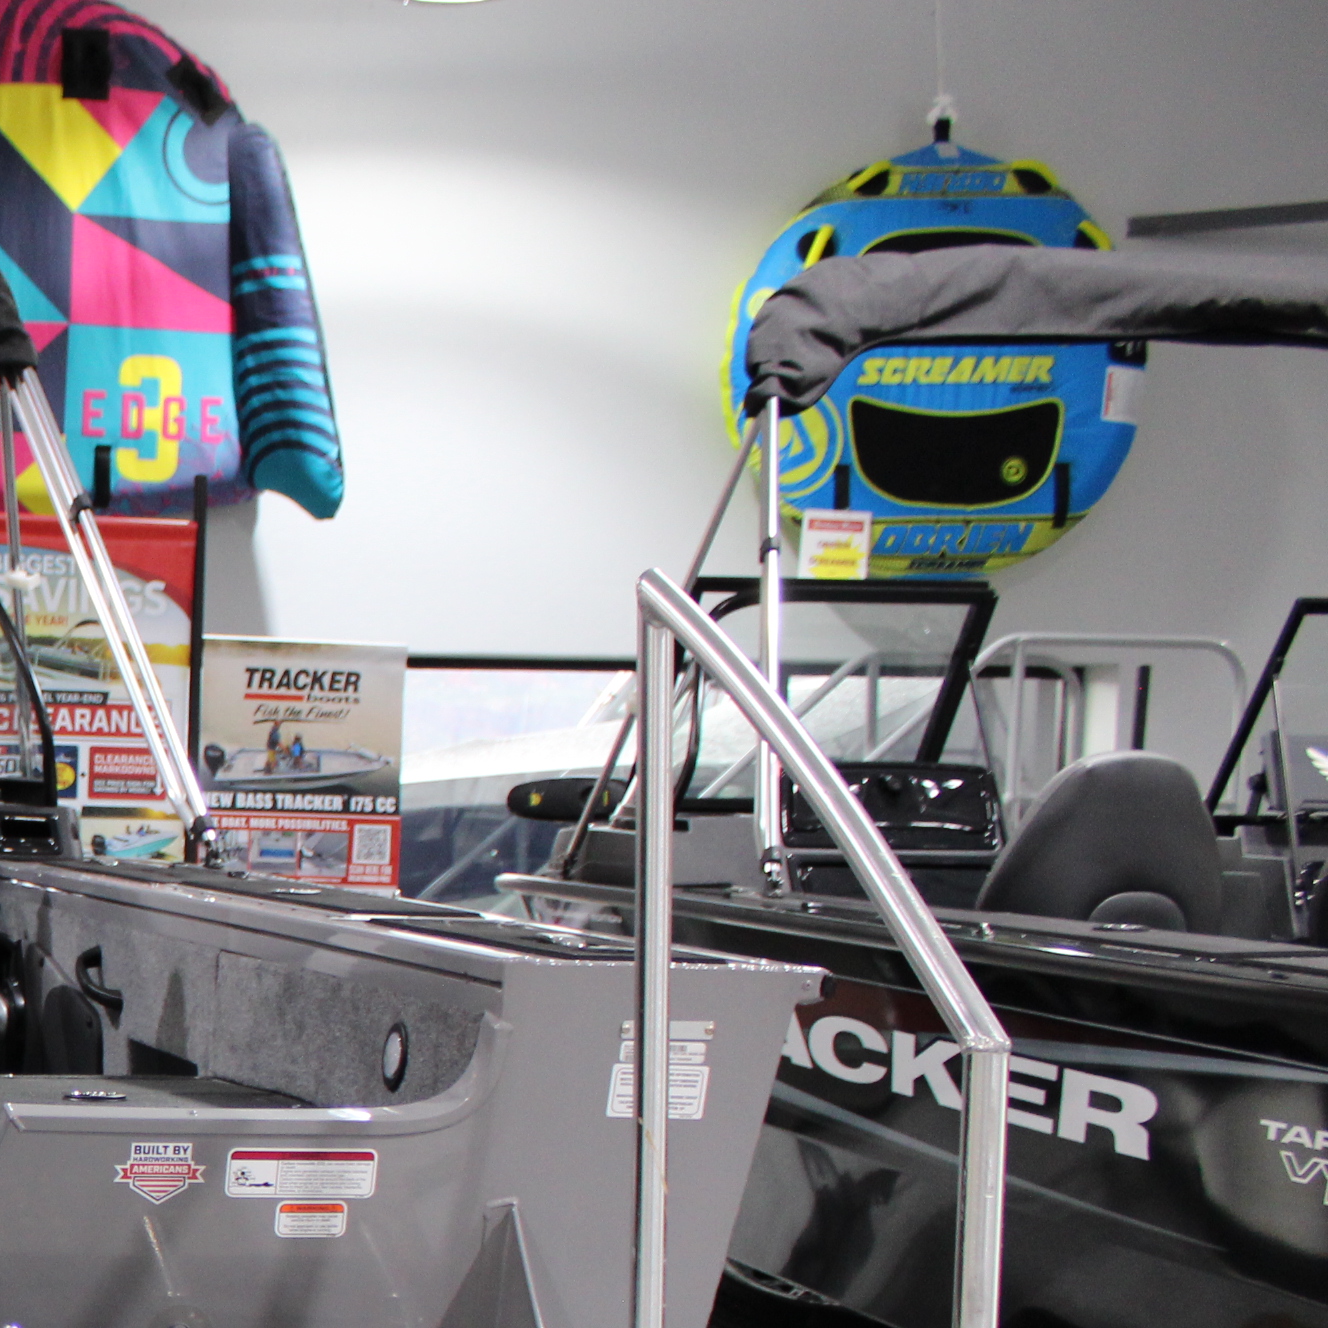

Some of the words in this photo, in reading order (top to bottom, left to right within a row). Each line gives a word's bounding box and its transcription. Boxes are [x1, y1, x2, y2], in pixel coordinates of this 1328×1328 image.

[857, 355, 1056, 386] SCREAMER
[81, 388, 224, 445] EDGE
[115, 354, 183, 483] 3
[245, 667, 361, 693] TRACKER
[94, 754, 155, 765] CLEARANC
[235, 791, 274, 810] BASS
[275, 793, 343, 812] TRACKER
[349, 796, 374, 813] 175
[375, 796, 397, 814] CC
[781, 1012, 1151, 1161] CKER
[134, 1145, 170, 1155] BUILT
[173, 1145, 190, 1155] BY
[131, 1165, 189, 1174] AMERICANS
